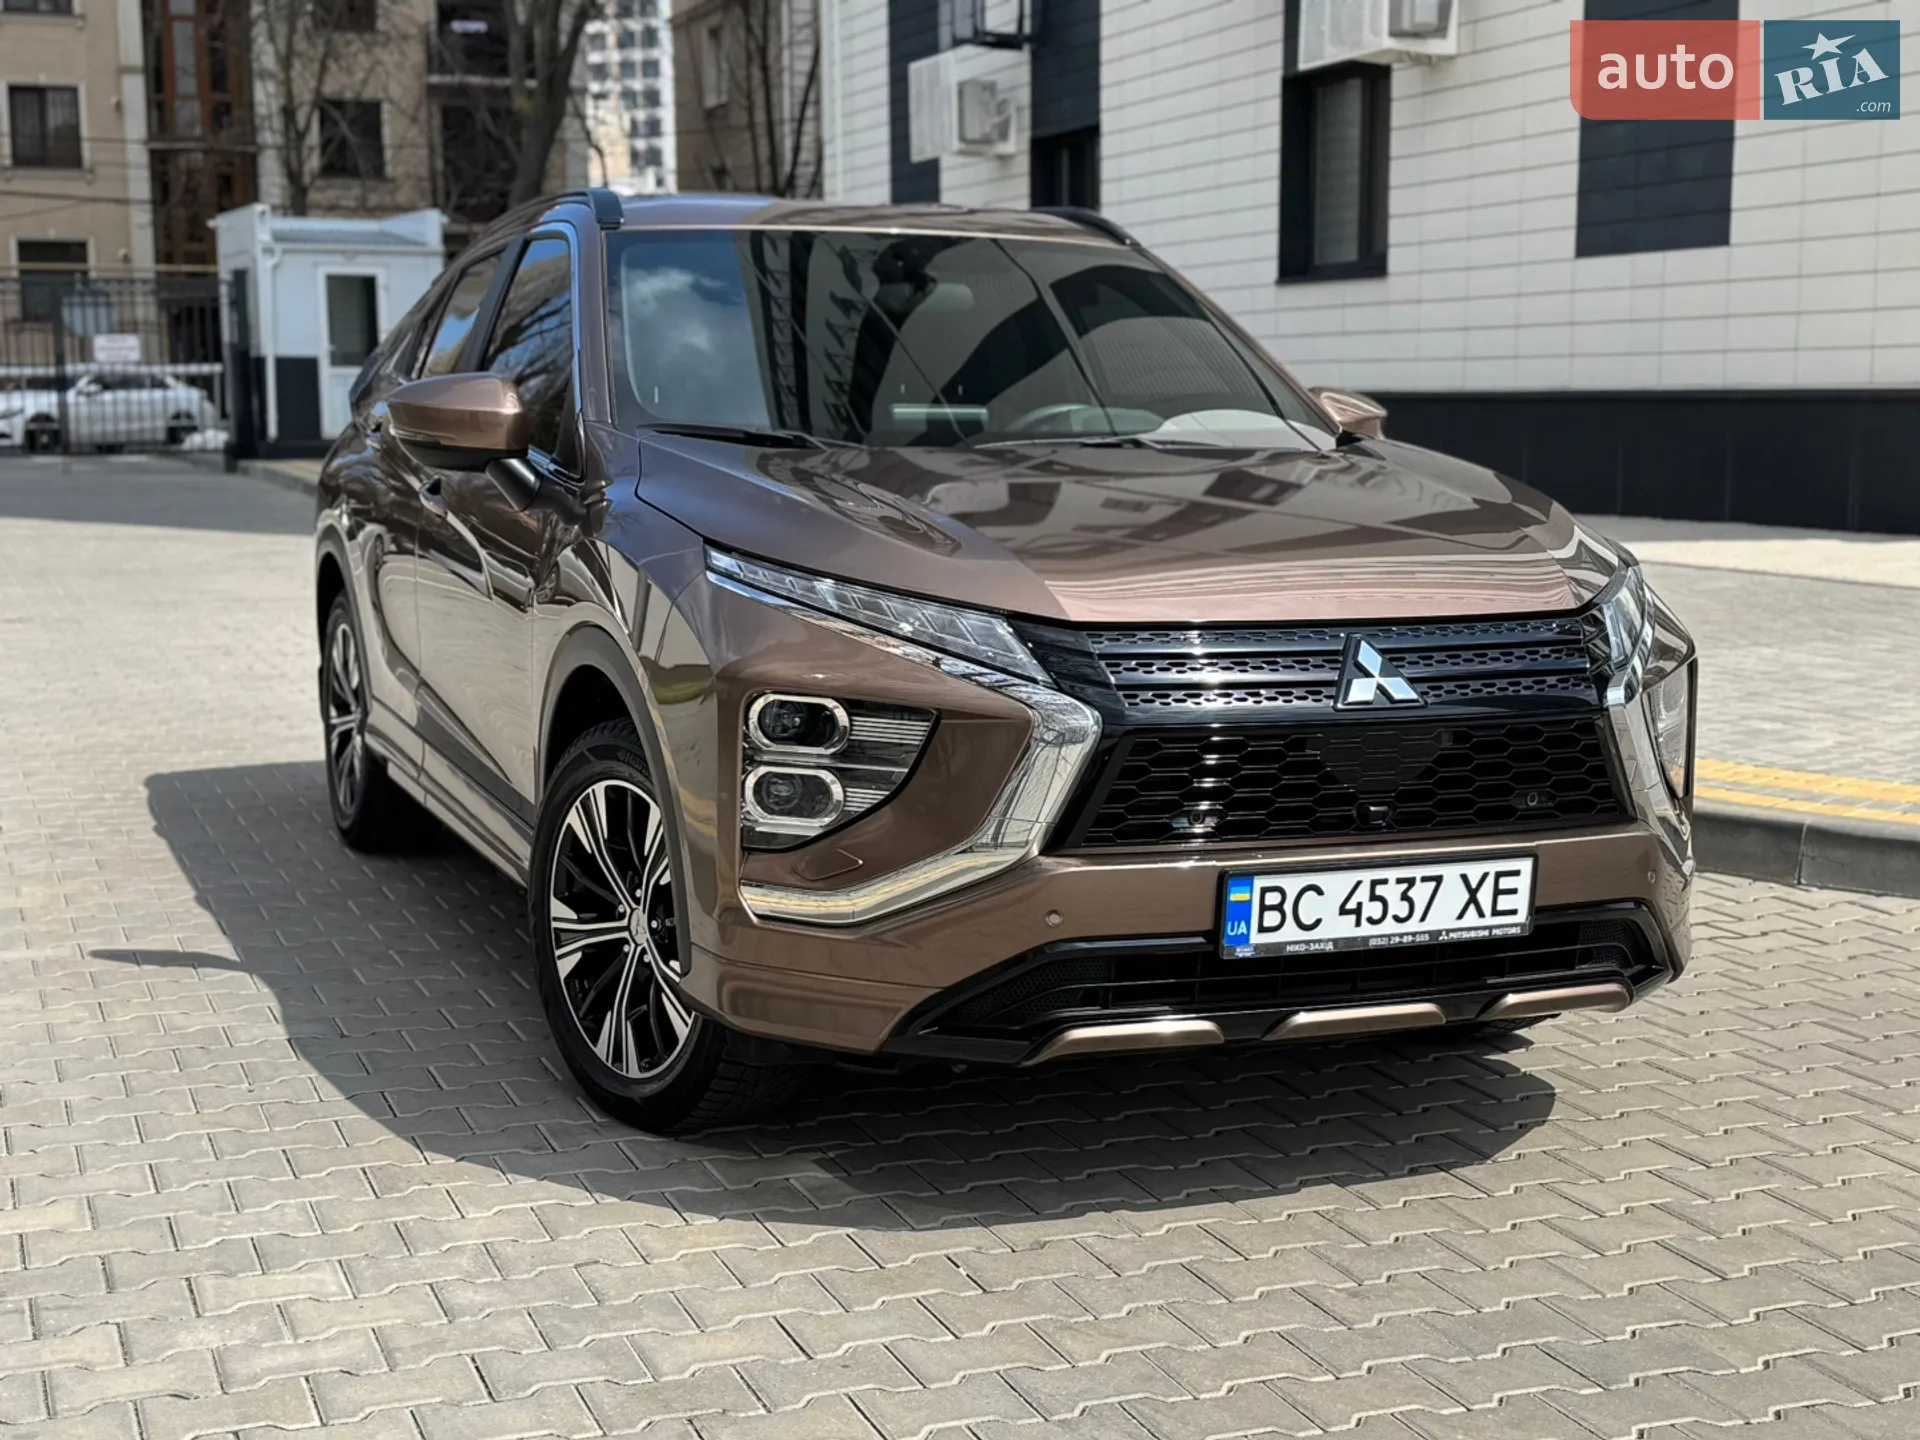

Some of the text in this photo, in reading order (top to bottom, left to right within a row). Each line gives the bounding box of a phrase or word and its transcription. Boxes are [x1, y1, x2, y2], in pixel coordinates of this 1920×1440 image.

[1257, 869, 1522, 933] BC 4537 XE
[1227, 921, 1247, 936] UA
[1449, 926, 1521, 939] MITSUBISHI MOTORS
